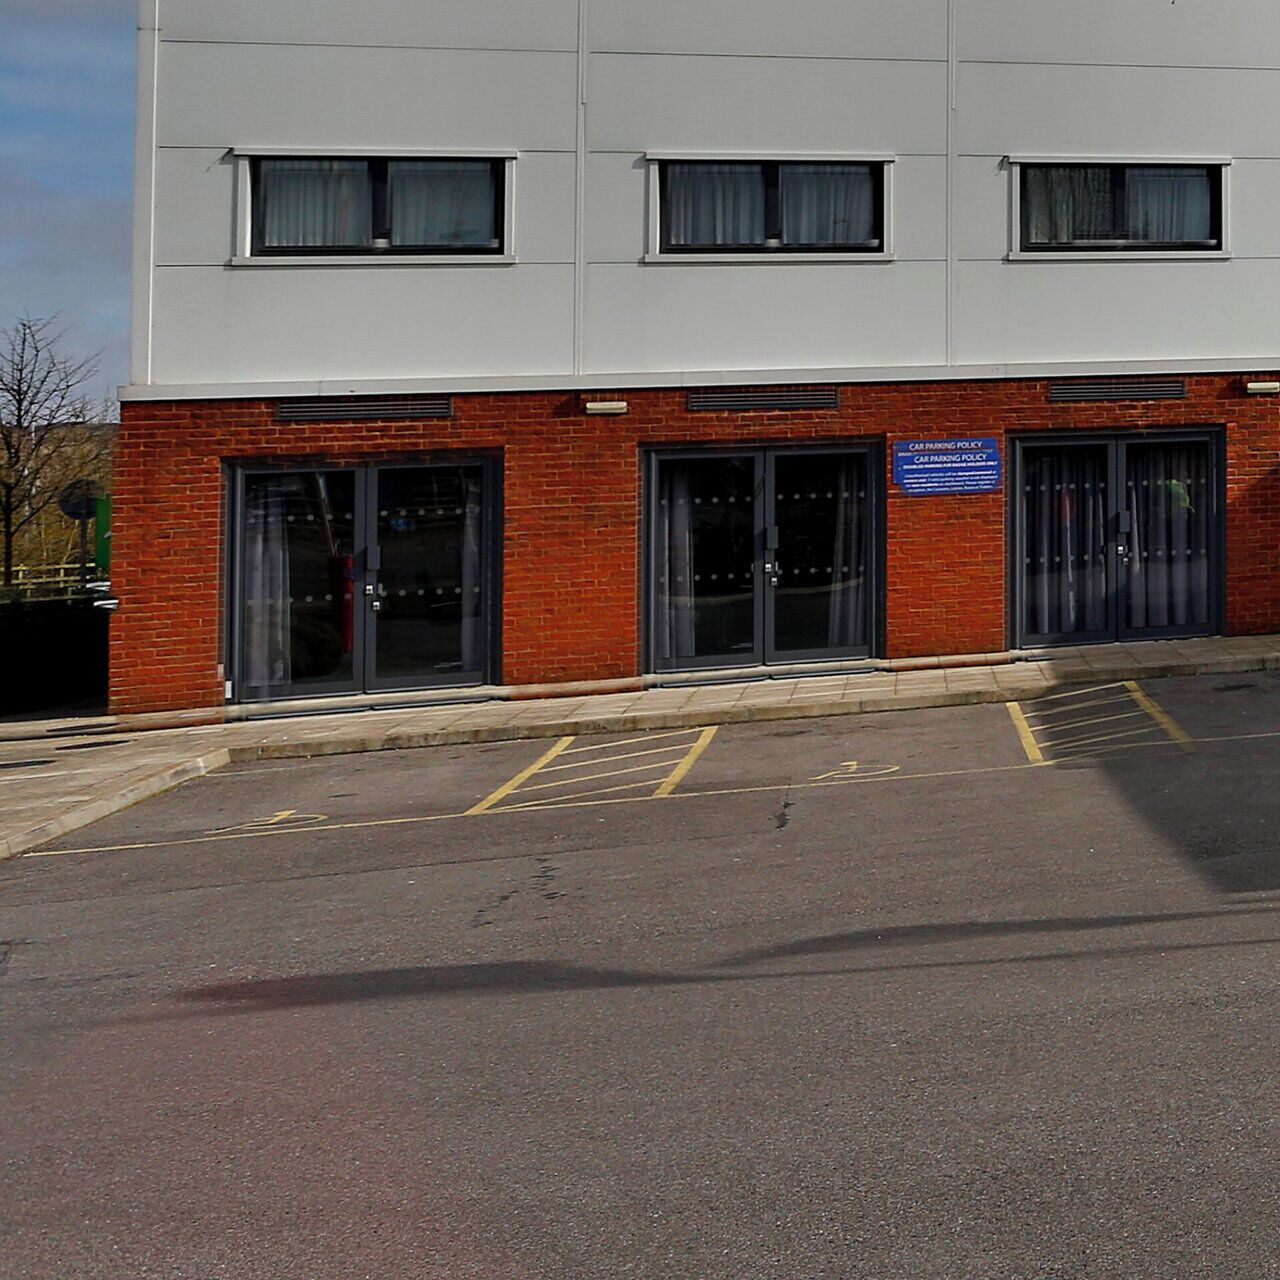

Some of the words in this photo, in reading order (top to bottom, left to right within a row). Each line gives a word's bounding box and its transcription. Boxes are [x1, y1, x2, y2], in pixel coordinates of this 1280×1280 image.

[909, 443, 924, 451] CAR
[925, 442, 955, 451] PARKING
[957, 441, 983, 449] POLICY
[914, 455, 929, 464] CAR
[930, 454, 960, 463] PARKING
[962, 453, 987, 461] POLICY
